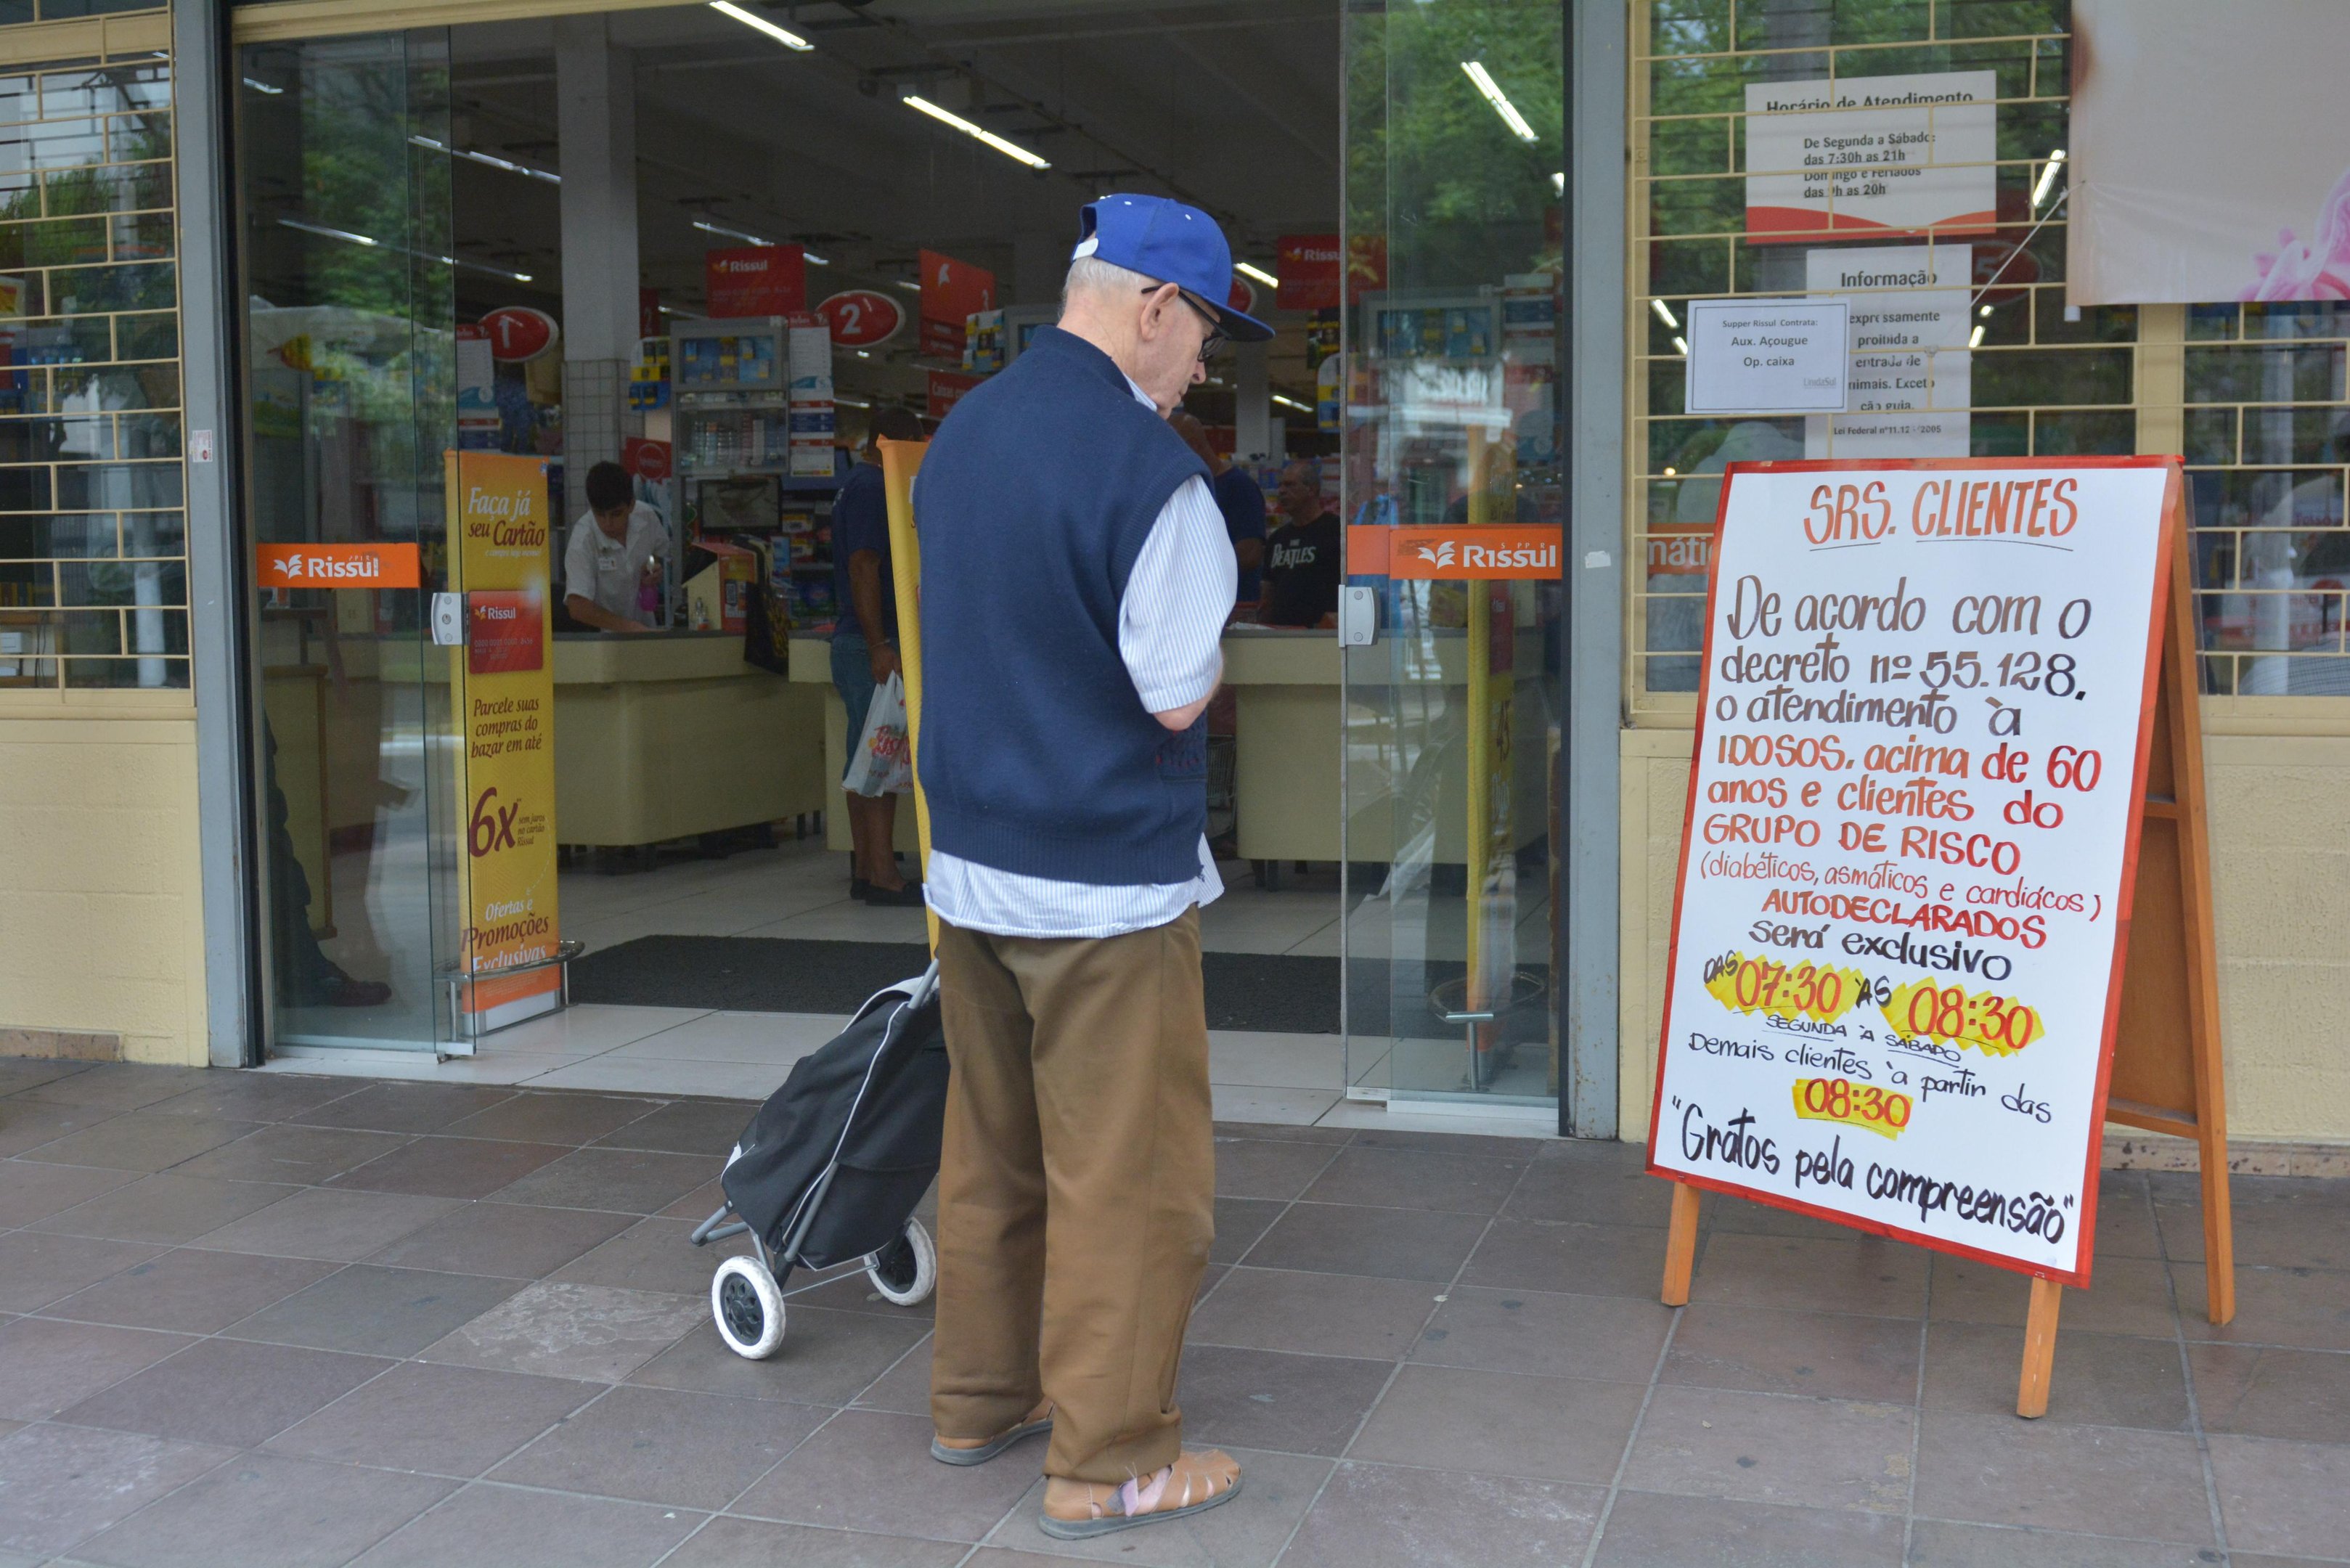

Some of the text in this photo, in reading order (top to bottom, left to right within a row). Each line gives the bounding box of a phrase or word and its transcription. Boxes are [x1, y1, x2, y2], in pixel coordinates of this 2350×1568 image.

[1804, 137, 1820, 150] De
[1823, 135, 1874, 150] Segunda
[1877, 136, 1885, 146] a
[1804, 149, 1906, 166] das 7:30h as 21h
[1804, 187, 1824, 198] das
[1846, 187, 1859, 196] as
[1864, 184, 1886, 195] 20h
[730, 259, 768, 273] Rissul
[1841, 269, 1938, 287] Informação
[839, 303, 862, 335] 2
[1723, 318, 1819, 330] Supper Rissul Contrata:
[1731, 335, 1808, 348] Aux. Açougue
[1912, 335, 1919, 345] a
[1744, 356, 1795, 369] Op. caixa
[1834, 426, 1846, 436] Lei
[1848, 425, 1877, 435] Federal
[468, 486, 531, 522] Faça já
[1803, 478, 2078, 544] SRS. CLIENTES
[468, 520, 545, 547] seu Cartão
[307, 555, 380, 578] Rissul
[1271, 542, 1317, 569] BEATLES
[1463, 544, 1557, 568] Rissul
[488, 607, 516, 620] Rissul
[1727, 574, 1782, 640] De
[1794, 576, 1926, 633] acordo
[1952, 593, 2041, 636] com
[1721, 632, 1851, 685] decreto
[473, 697, 540, 717] Parcele suas
[1715, 685, 2022, 737] o atendimento à
[476, 715, 539, 738] compras do
[470, 732, 543, 759] bazar em até
[1864, 735, 1970, 779] acima
[1980, 741, 2030, 785] de
[2046, 745, 2102, 793] 60
[1707, 774, 2065, 830] anos e clientes do
[517, 836, 534, 848] Rissul
[1702, 812, 2022, 876] GRUPO DE RISCO
[1700, 850, 1821, 886] (diabéticos,
[1824, 861, 1929, 899] asmáticos
[1938, 883, 1955, 902] e
[485, 898, 534, 923] Ofertas e
[1761, 888, 2047, 950] AUTODECLARADOS
[461, 912, 550, 953] Promoções
[472, 944, 547, 973] Exclusivas
[1841, 931, 2012, 981] exclusivo
[1734, 959, 1843, 1014] 07:30
[1908, 986, 2034, 1050] 08:30
[1765, 1013, 1848, 1038] SEGUNDA
[1689, 1032, 1776, 1061] Demais
[1784, 1043, 1873, 1081] clientes
[2001, 1082, 2053, 1124] das
[1804, 1077, 1912, 1128] 08:30
[1795, 1134, 1856, 1189] pela
